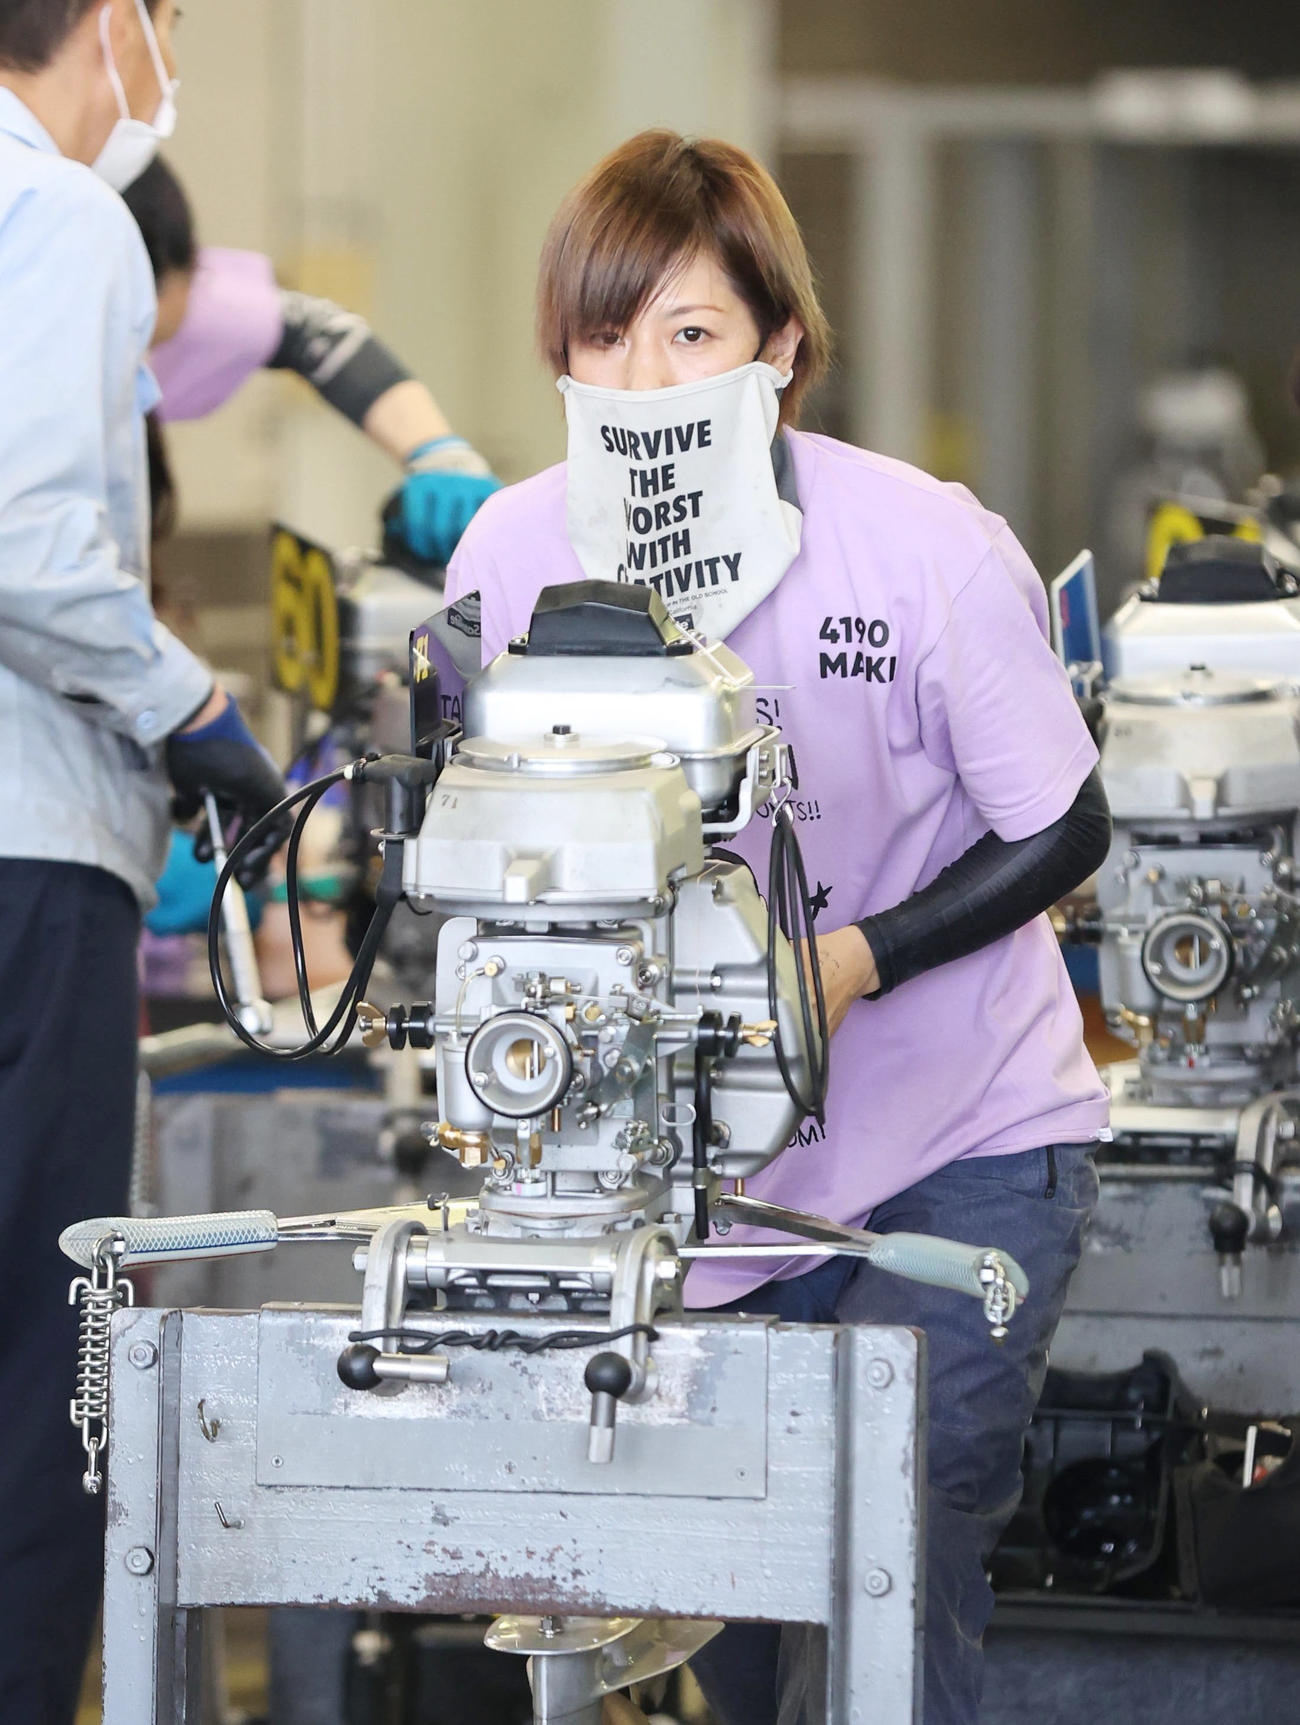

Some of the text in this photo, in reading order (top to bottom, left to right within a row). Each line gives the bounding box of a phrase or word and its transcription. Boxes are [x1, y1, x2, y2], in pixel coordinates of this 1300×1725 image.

[601, 419, 712, 460] SURVIVE
[629, 463, 675, 498] THE
[819, 616, 889, 648] 4190
[819, 651, 897, 683] MAKI
